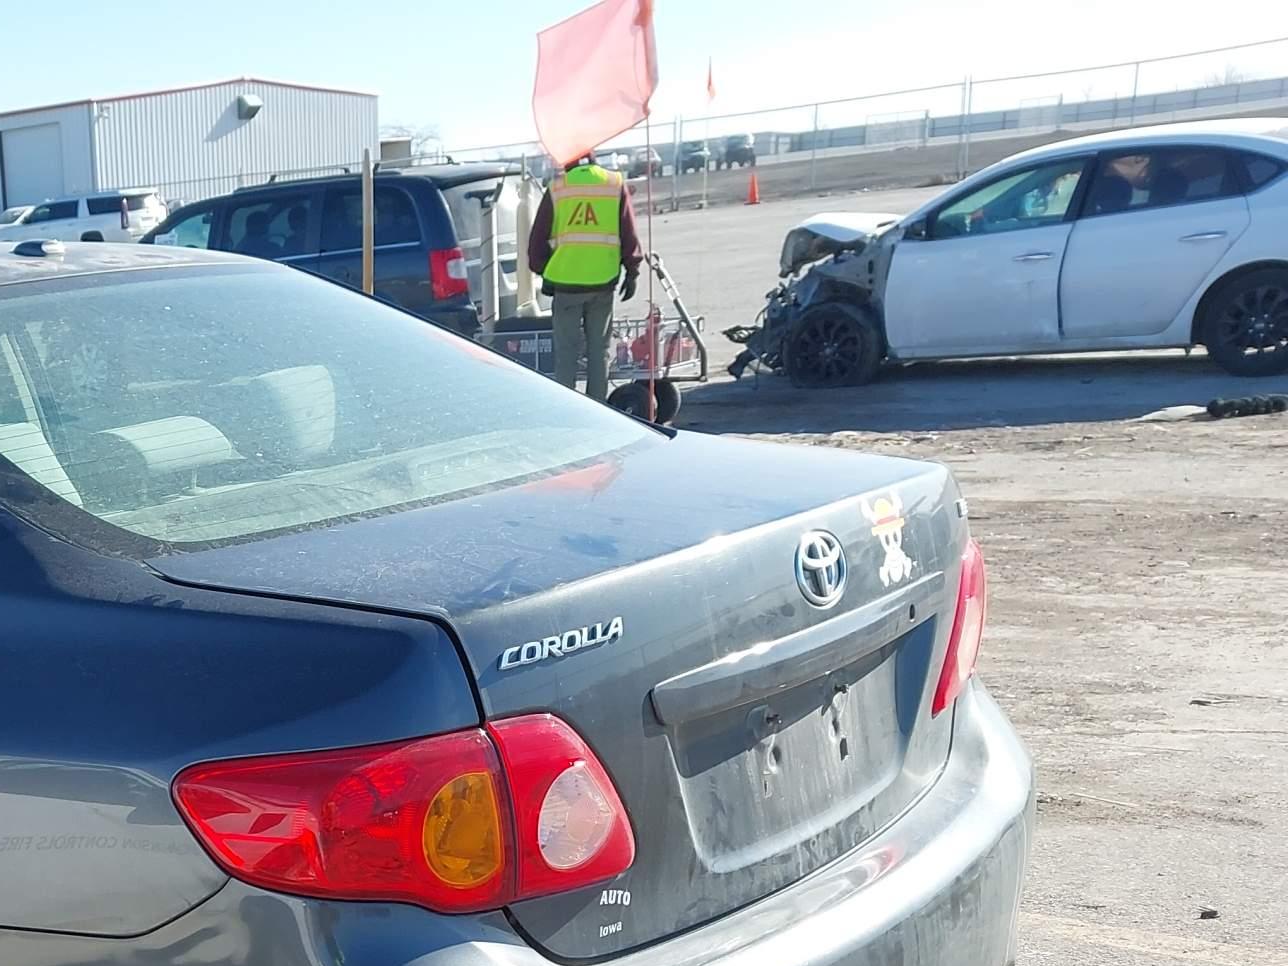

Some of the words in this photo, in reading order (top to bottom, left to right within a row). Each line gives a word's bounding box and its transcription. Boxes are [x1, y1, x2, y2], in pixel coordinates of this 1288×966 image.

[498, 616, 625, 669] COROLLA
[599, 889, 631, 906] AUTO
[599, 920, 622, 938] Iowa
